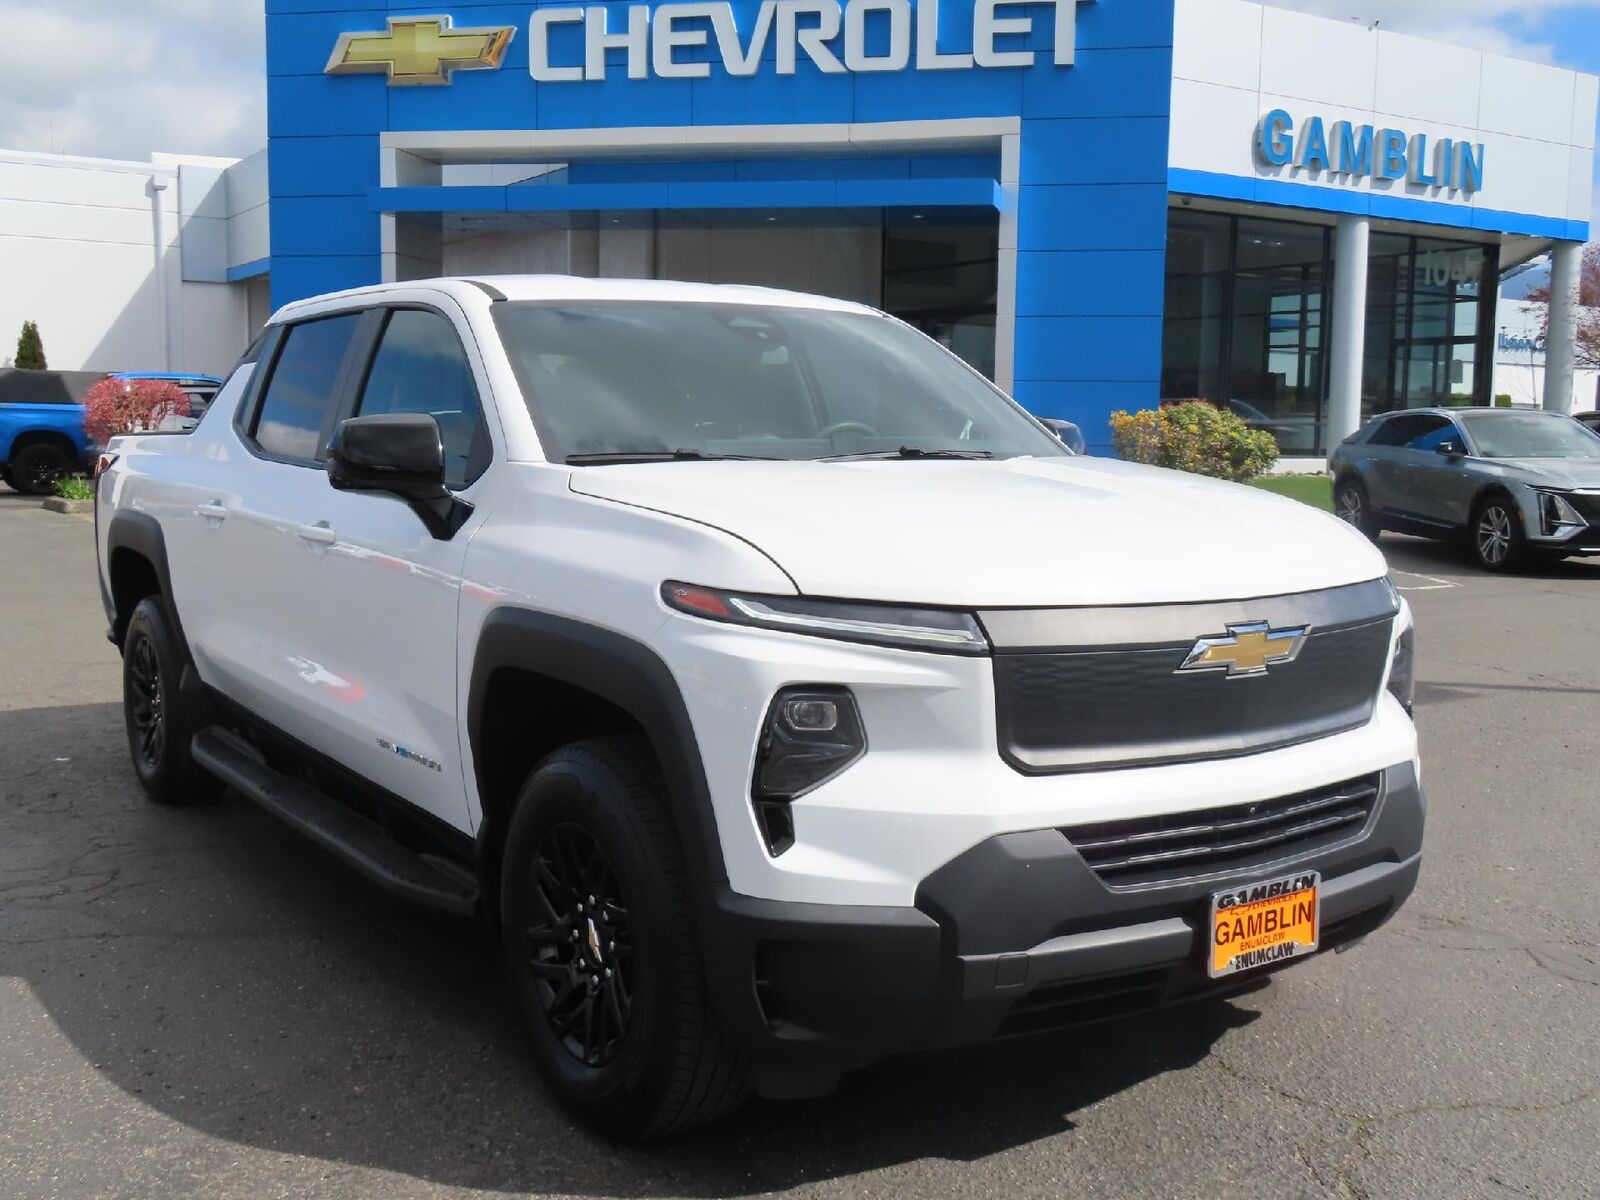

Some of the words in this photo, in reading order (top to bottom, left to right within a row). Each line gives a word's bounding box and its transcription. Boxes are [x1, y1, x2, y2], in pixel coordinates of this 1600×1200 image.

[529, 0, 1094, 81] CHEVROLET
[1258, 108, 1484, 192] GAMBLIN
[1218, 874, 1315, 909] GAMBLIN
[1215, 901, 1312, 945] GAMBLIN
[1240, 931, 1285, 951] ENUMCLAW
[1235, 942, 1294, 969] ENUMCLAW
